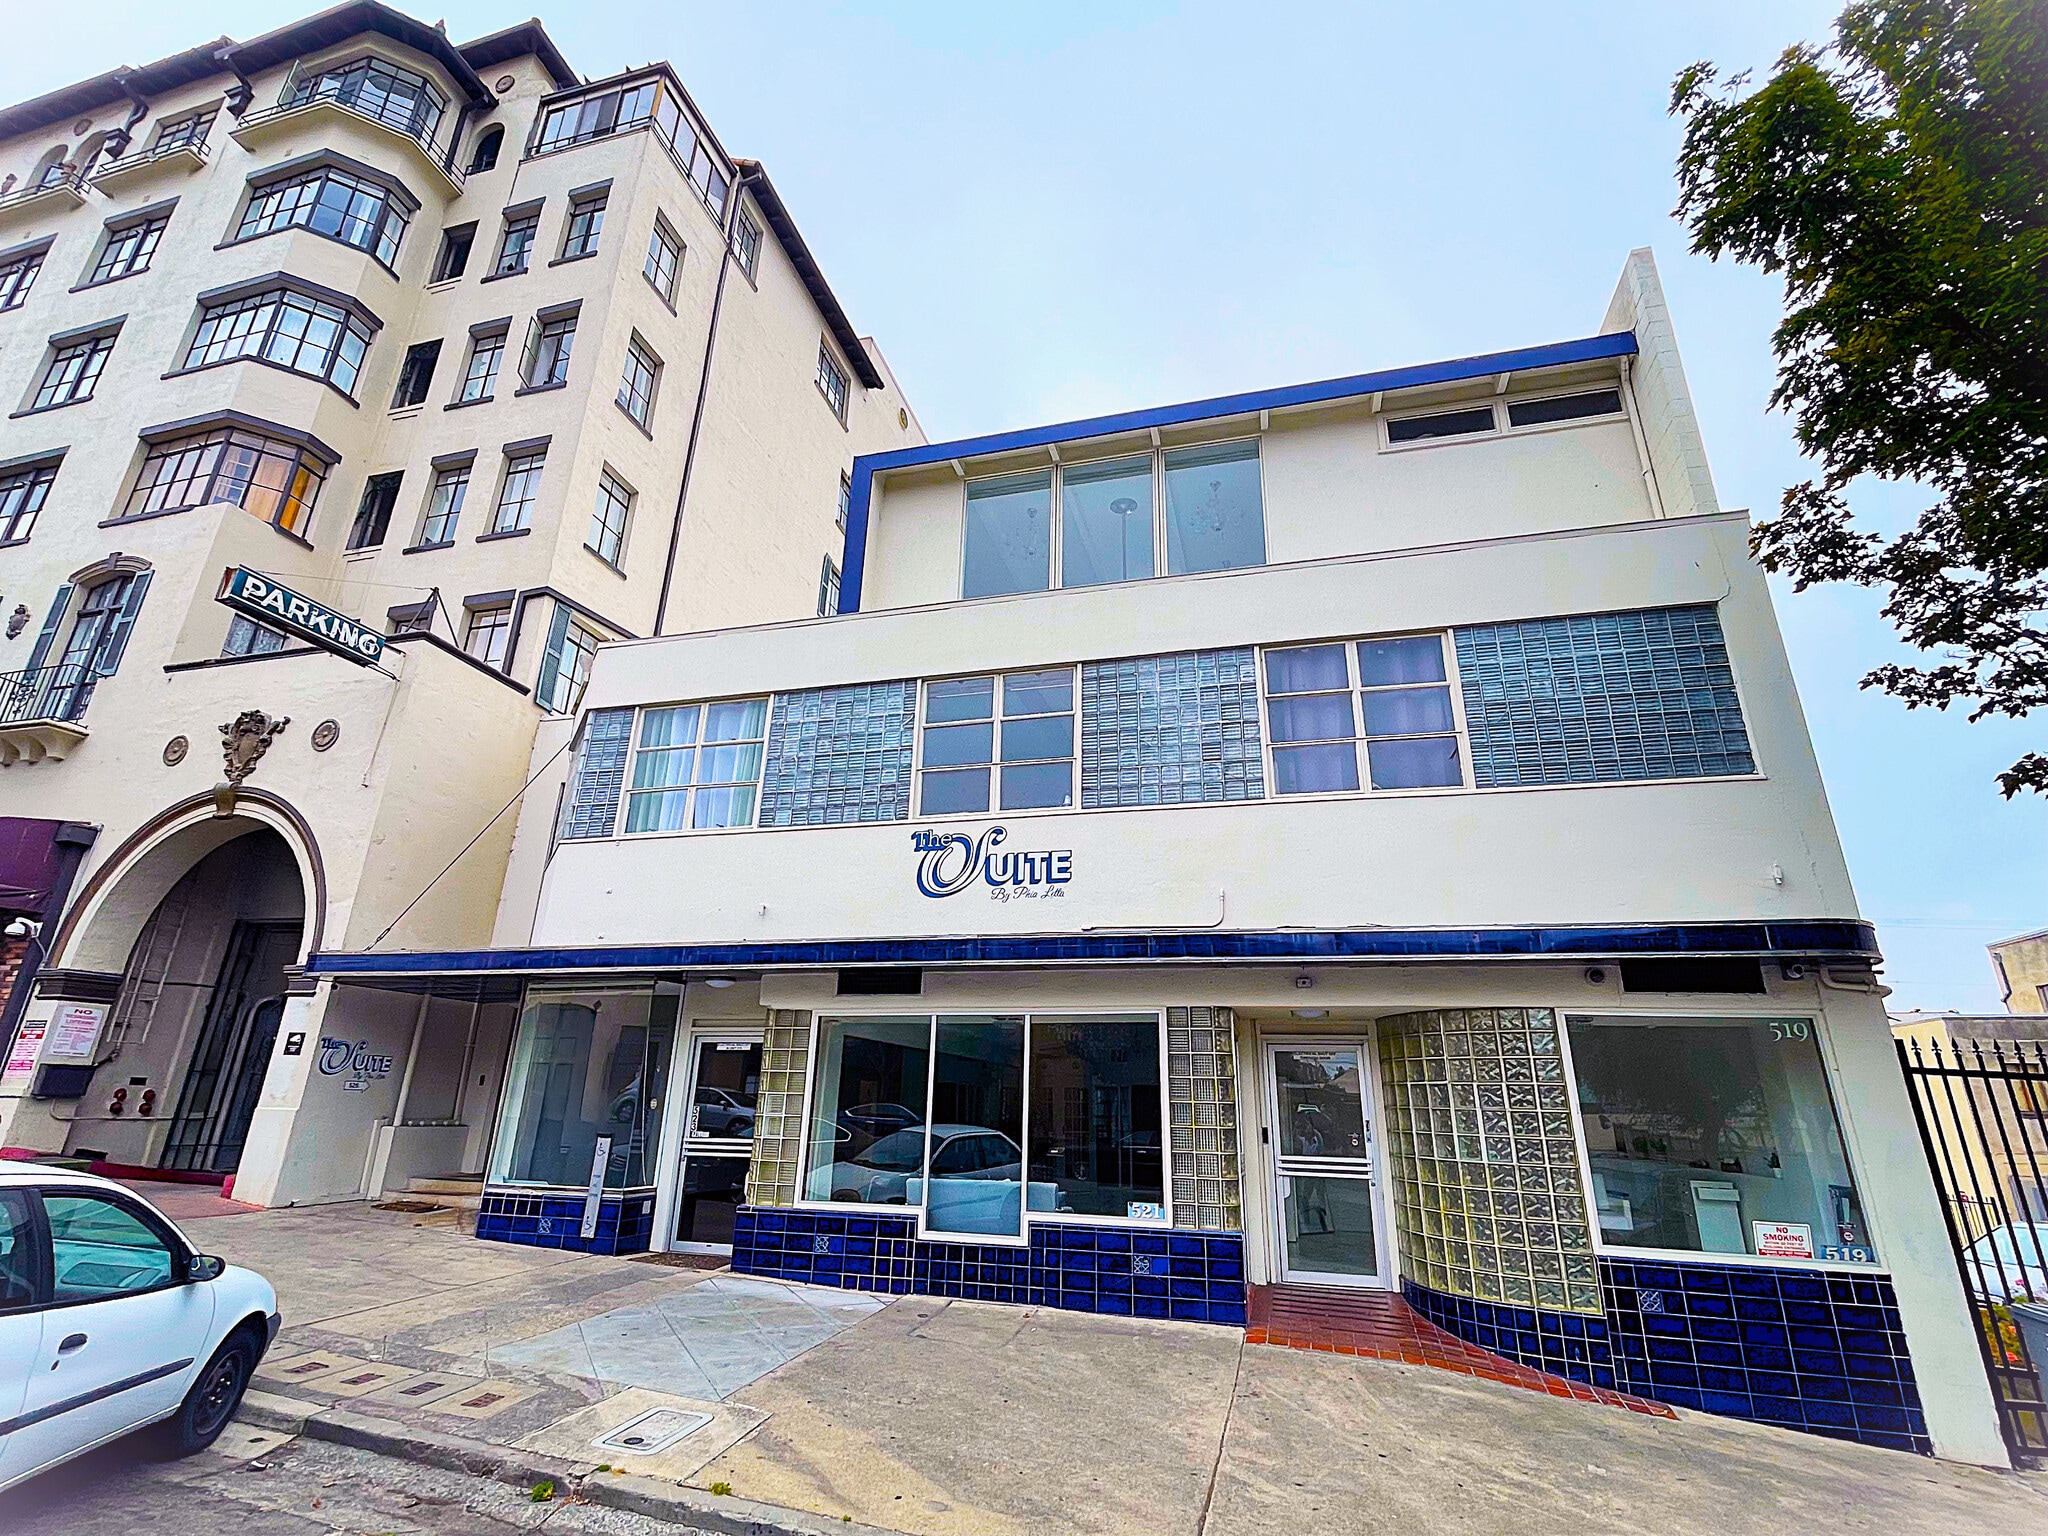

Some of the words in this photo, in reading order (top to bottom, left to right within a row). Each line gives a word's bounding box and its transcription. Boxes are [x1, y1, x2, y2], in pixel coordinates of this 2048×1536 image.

[242, 575, 380, 656] PARKING
[911, 829, 954, 852] The
[917, 826, 1073, 898] SUITE
[991, 887, 1010, 903] By
[1769, 1022, 1809, 1042] 519
[321, 1036, 342, 1049] The
[319, 1039, 393, 1076] SUITE
[1132, 1204, 1160, 1219] 521
[1763, 1234, 1804, 1242] SMOKING
[1776, 1226, 1788, 1234] NO
[1826, 1247, 1867, 1262] 519
